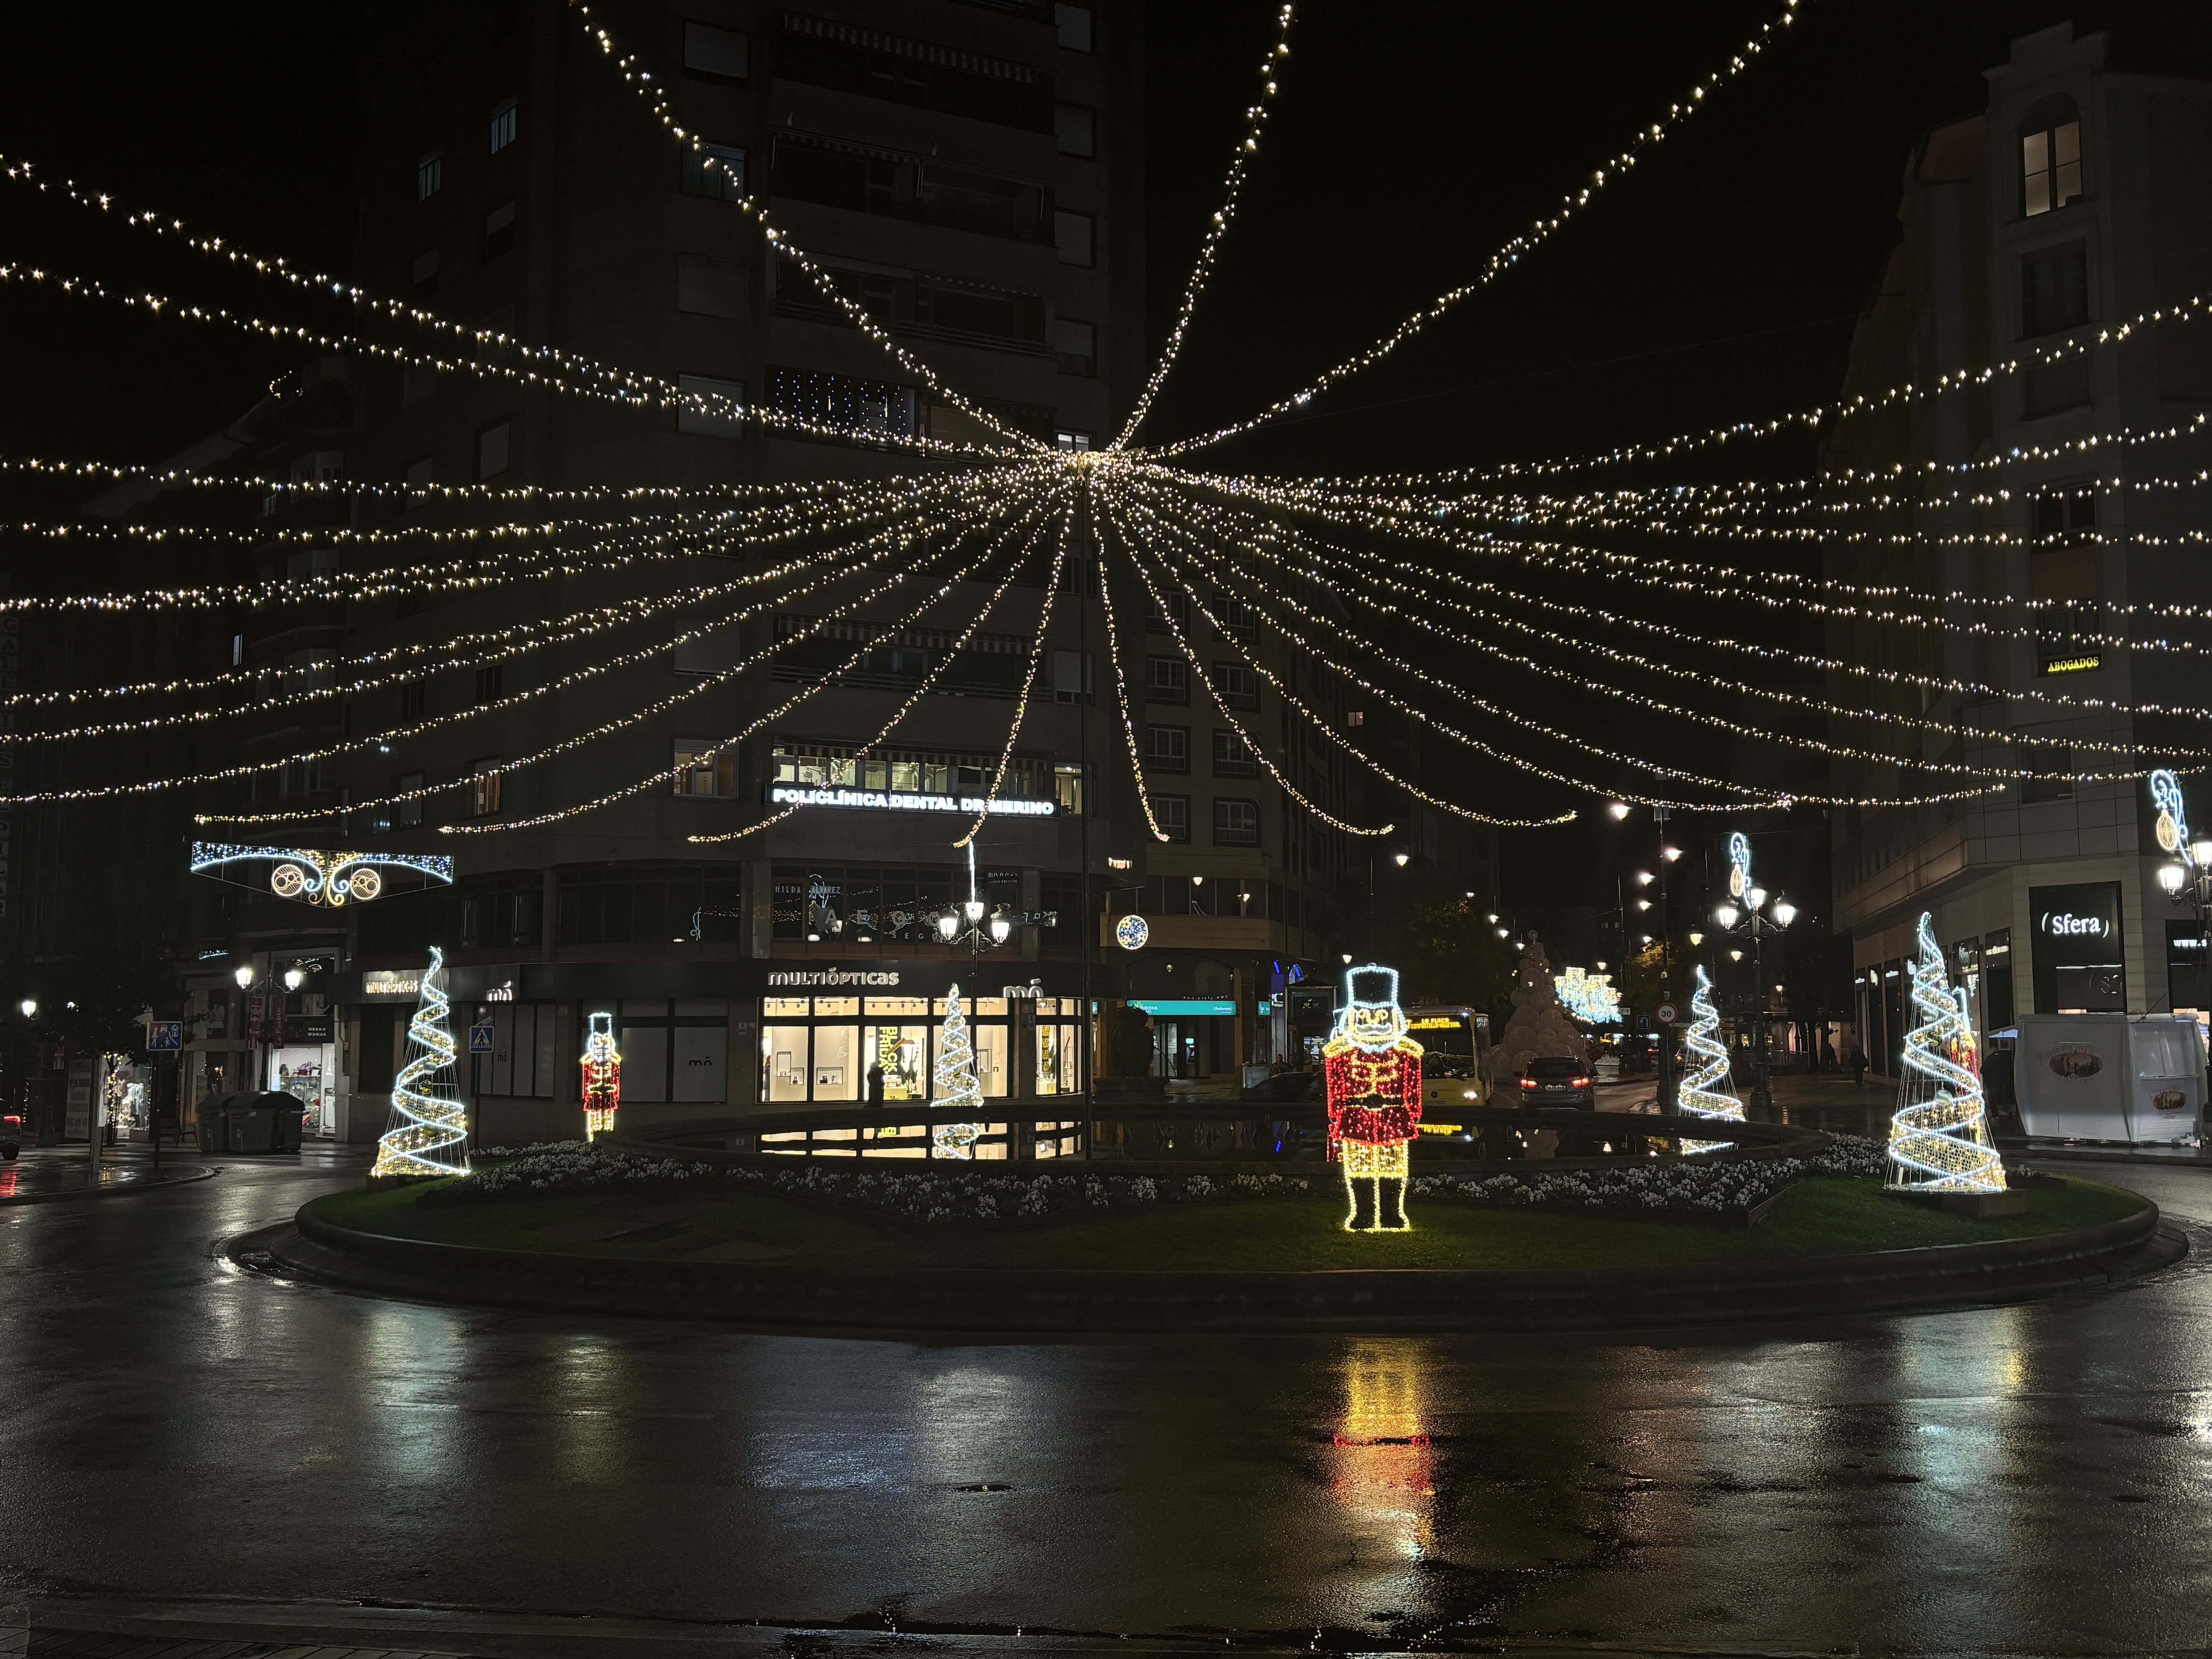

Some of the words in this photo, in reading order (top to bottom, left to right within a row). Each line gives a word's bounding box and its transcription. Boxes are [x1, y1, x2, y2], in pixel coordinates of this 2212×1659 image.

[2048, 656, 2099, 673] ABOGADOS
[773, 788, 888, 808] POLICLÍNICA
[891, 795, 958, 811] DENTAL
[987, 800, 1054, 815] MERINO
[775, 885, 801, 893] HILDA
